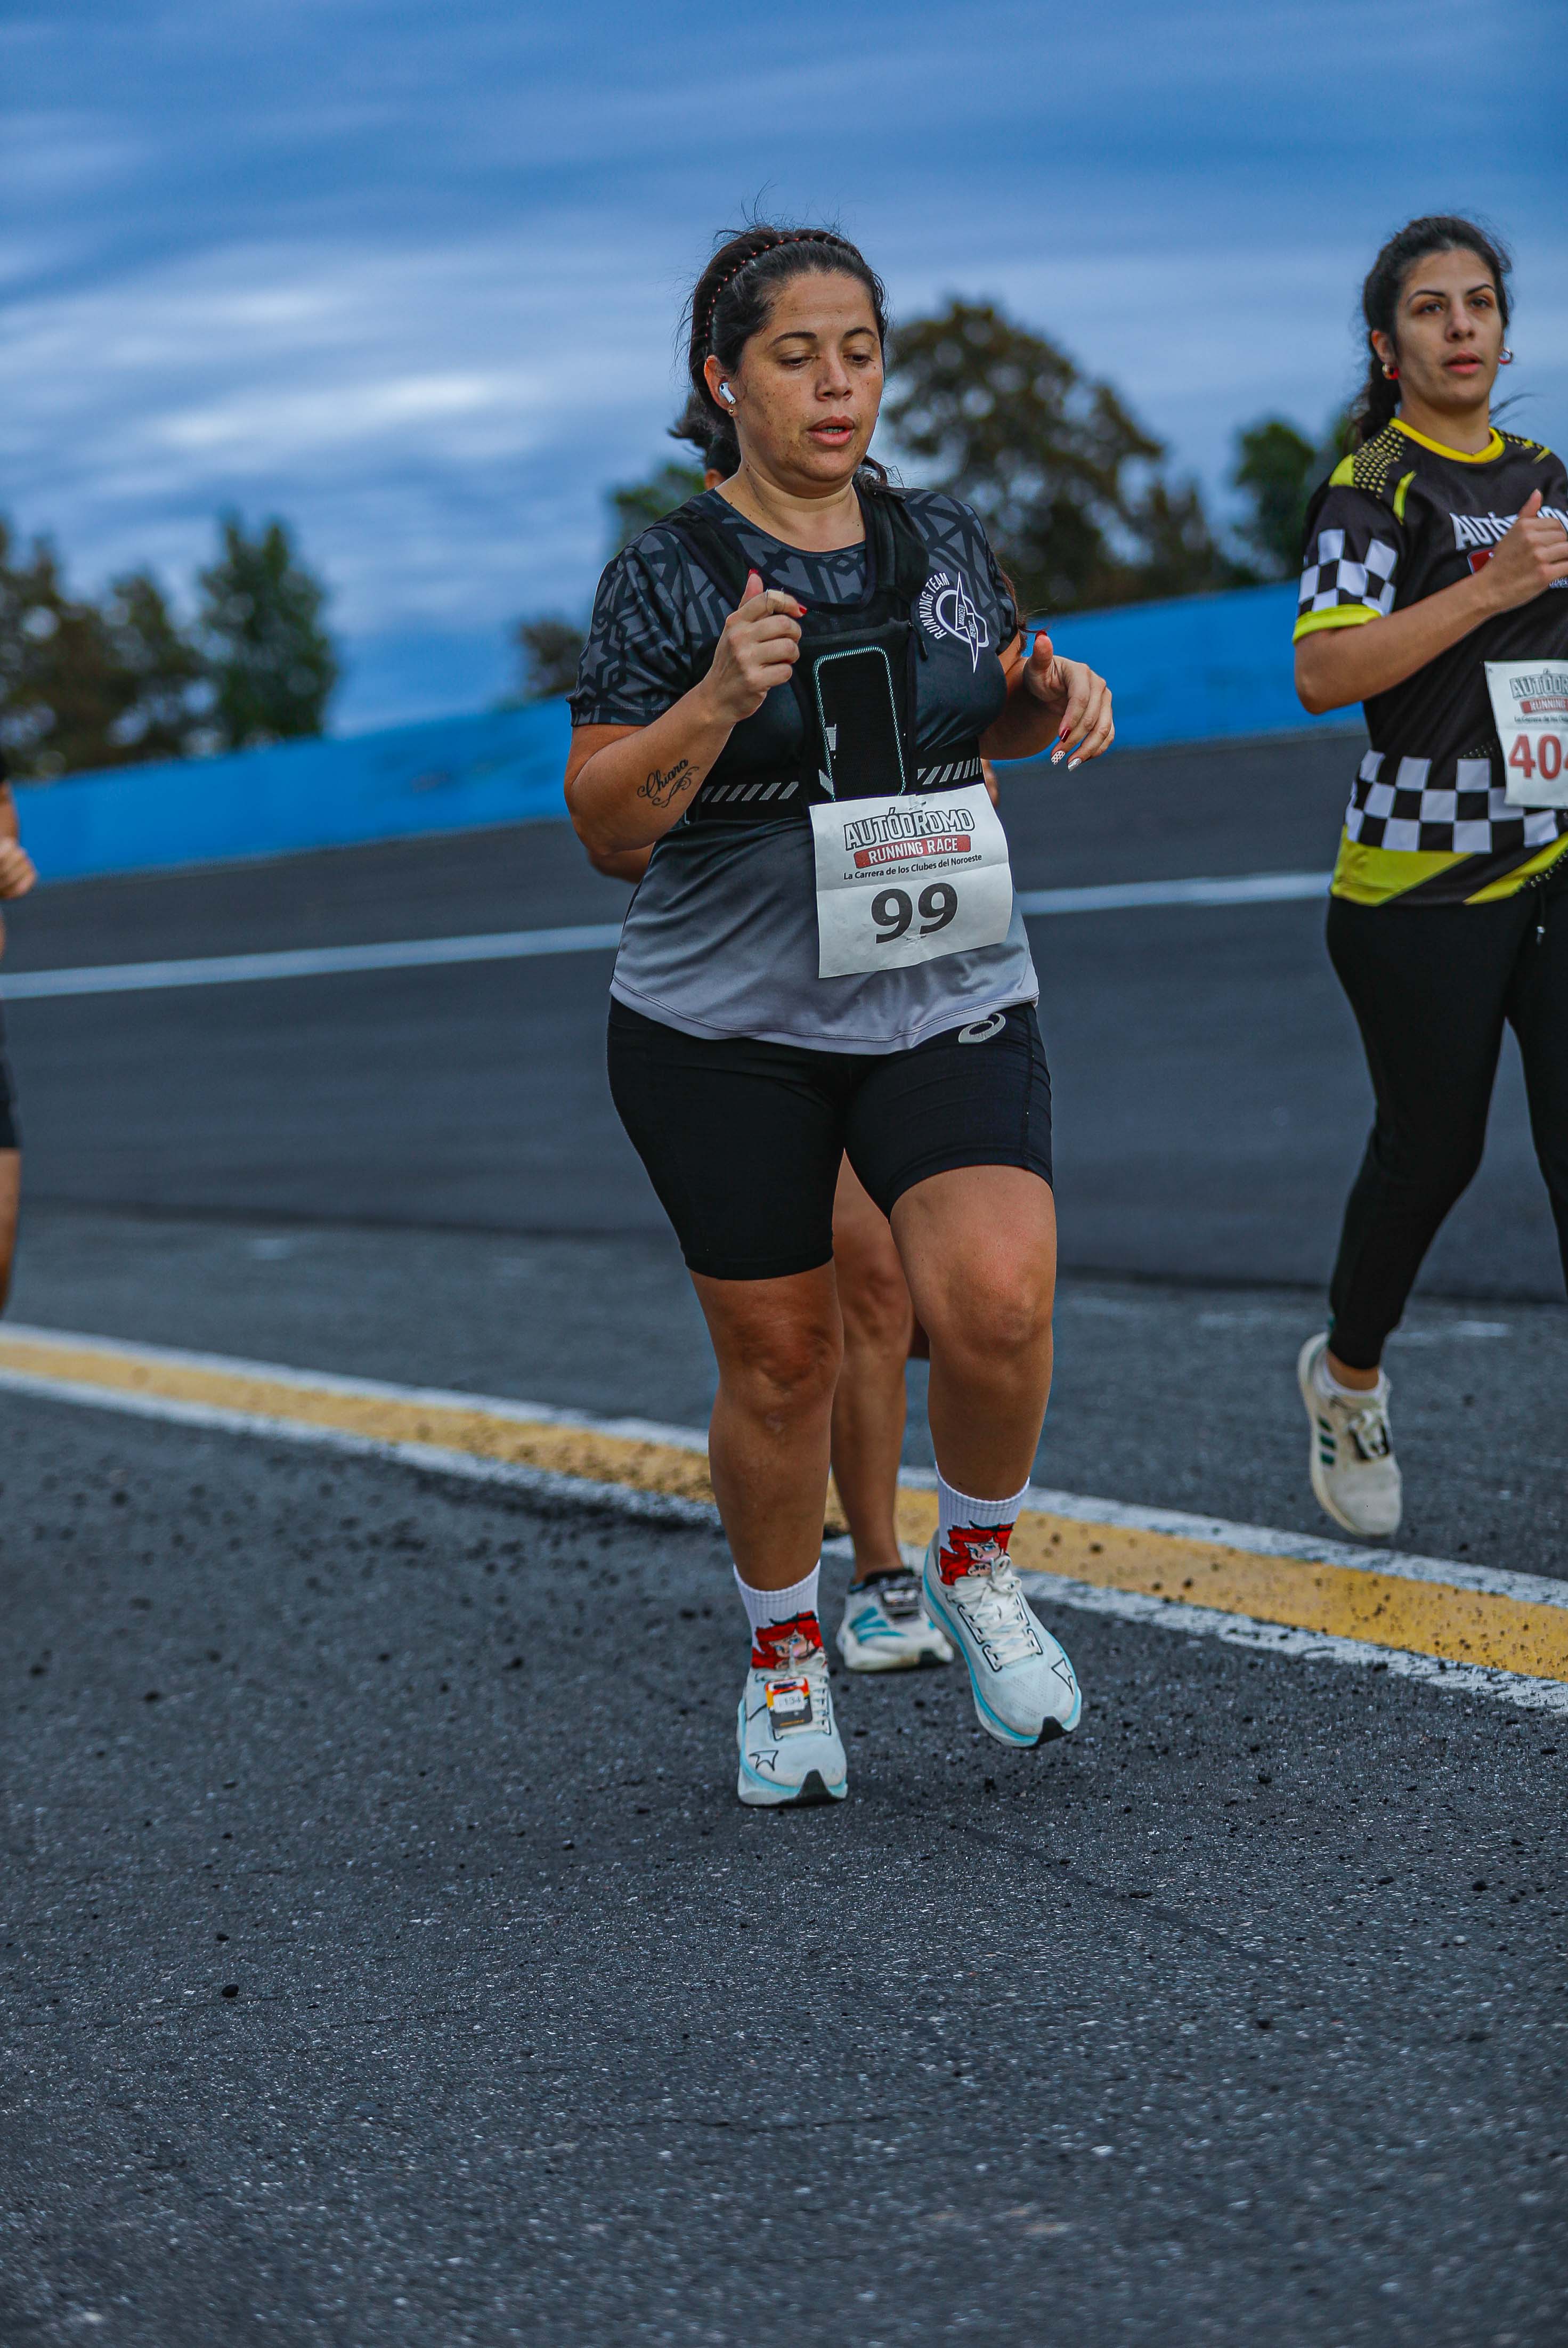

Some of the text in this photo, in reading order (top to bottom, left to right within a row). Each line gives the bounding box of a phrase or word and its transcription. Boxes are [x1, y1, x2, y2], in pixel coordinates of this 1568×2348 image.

[919, 573, 950, 639] RUNNING TEAM
[1509, 734, 1568, 779] 40
[844, 807, 975, 851] AUTÓDROMO
[868, 838, 958, 864] RUNNING RACE
[855, 870, 884, 879] Carrera
[886, 866, 896, 875] de
[898, 865, 909, 874] los
[911, 863, 937, 872] Clubes
[938, 859, 949, 868] del
[950, 854, 982, 866] Noroeste
[871, 882, 958, 945] 99
